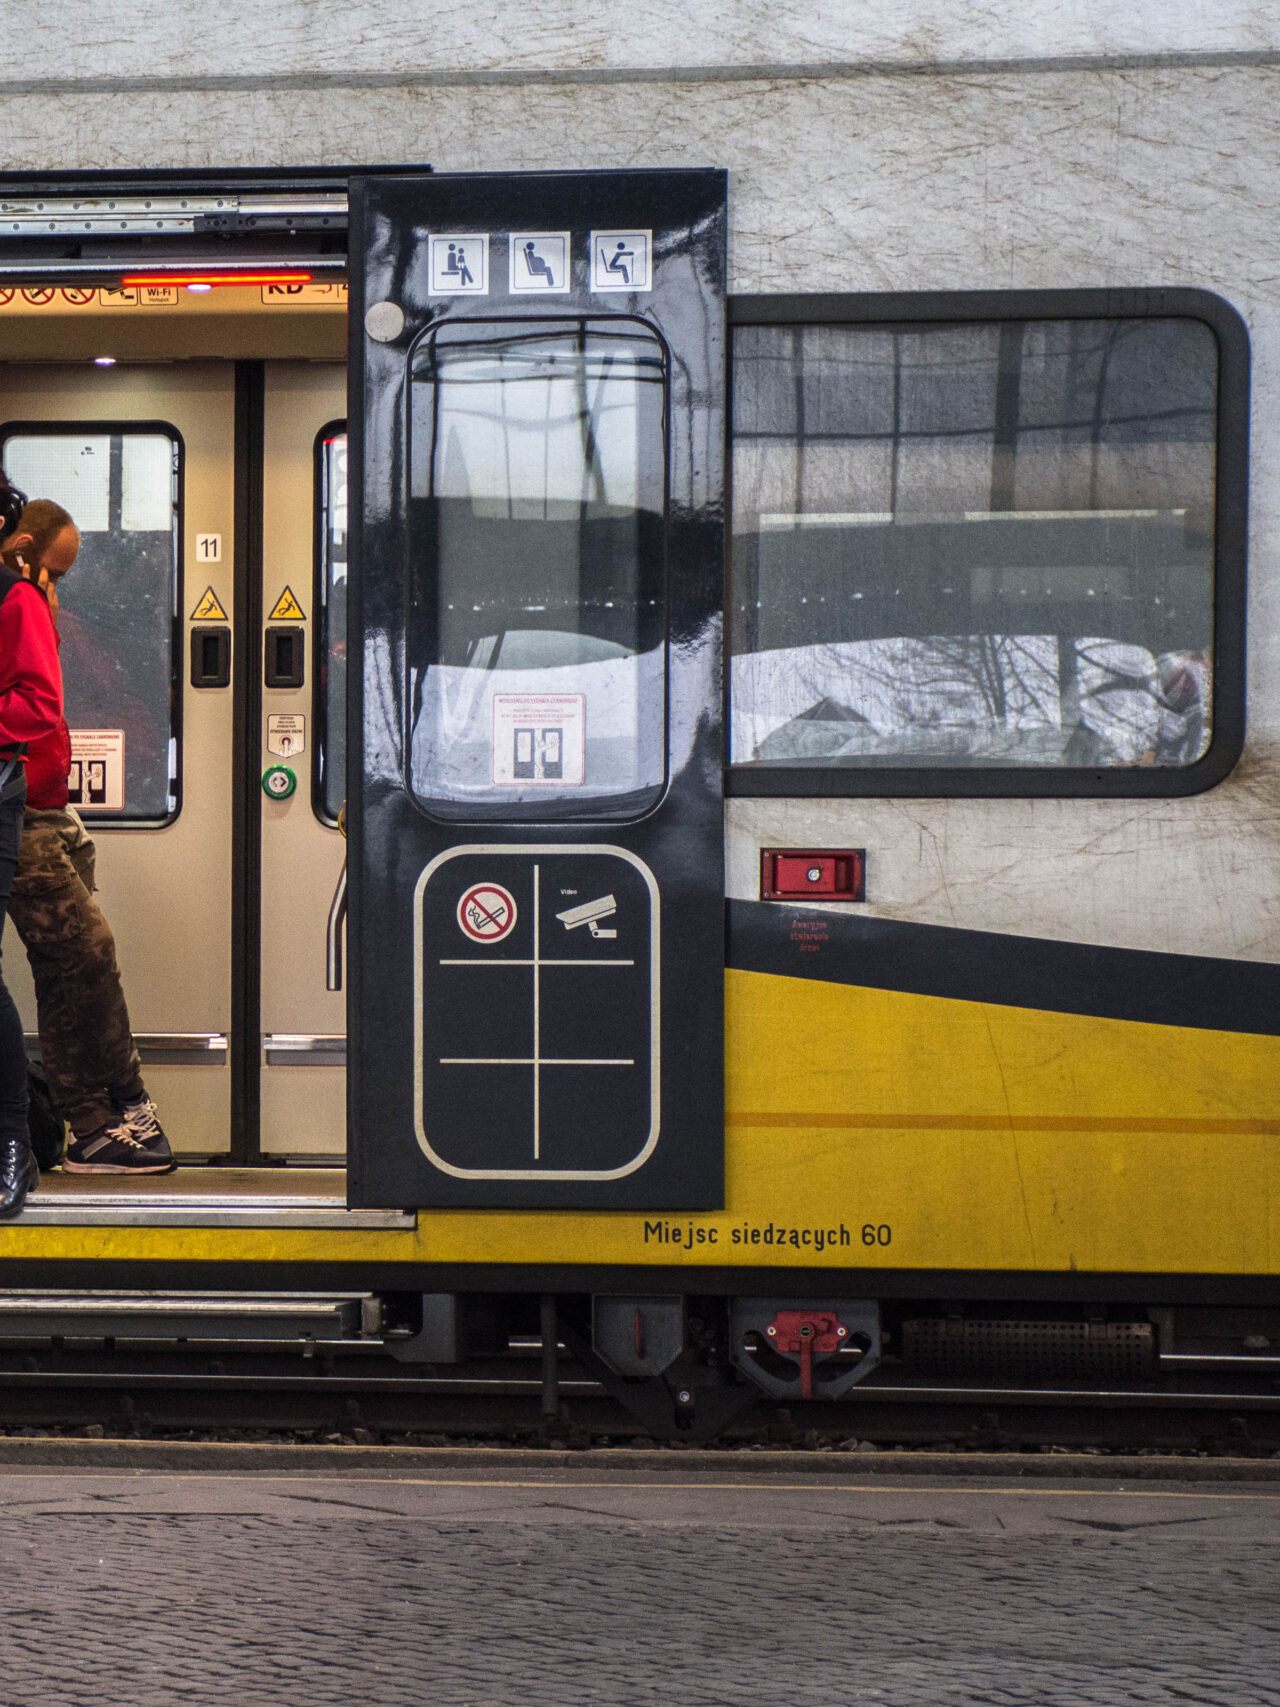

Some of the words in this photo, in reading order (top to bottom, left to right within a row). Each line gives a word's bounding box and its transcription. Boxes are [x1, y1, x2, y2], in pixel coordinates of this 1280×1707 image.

[147, 288, 171, 296] Wi-Fi
[201, 539, 218, 558] 11
[644, 1221, 718, 1249] Miejsc
[731, 1222, 850, 1251] siedzących
[862, 1224, 892, 1246] 60
